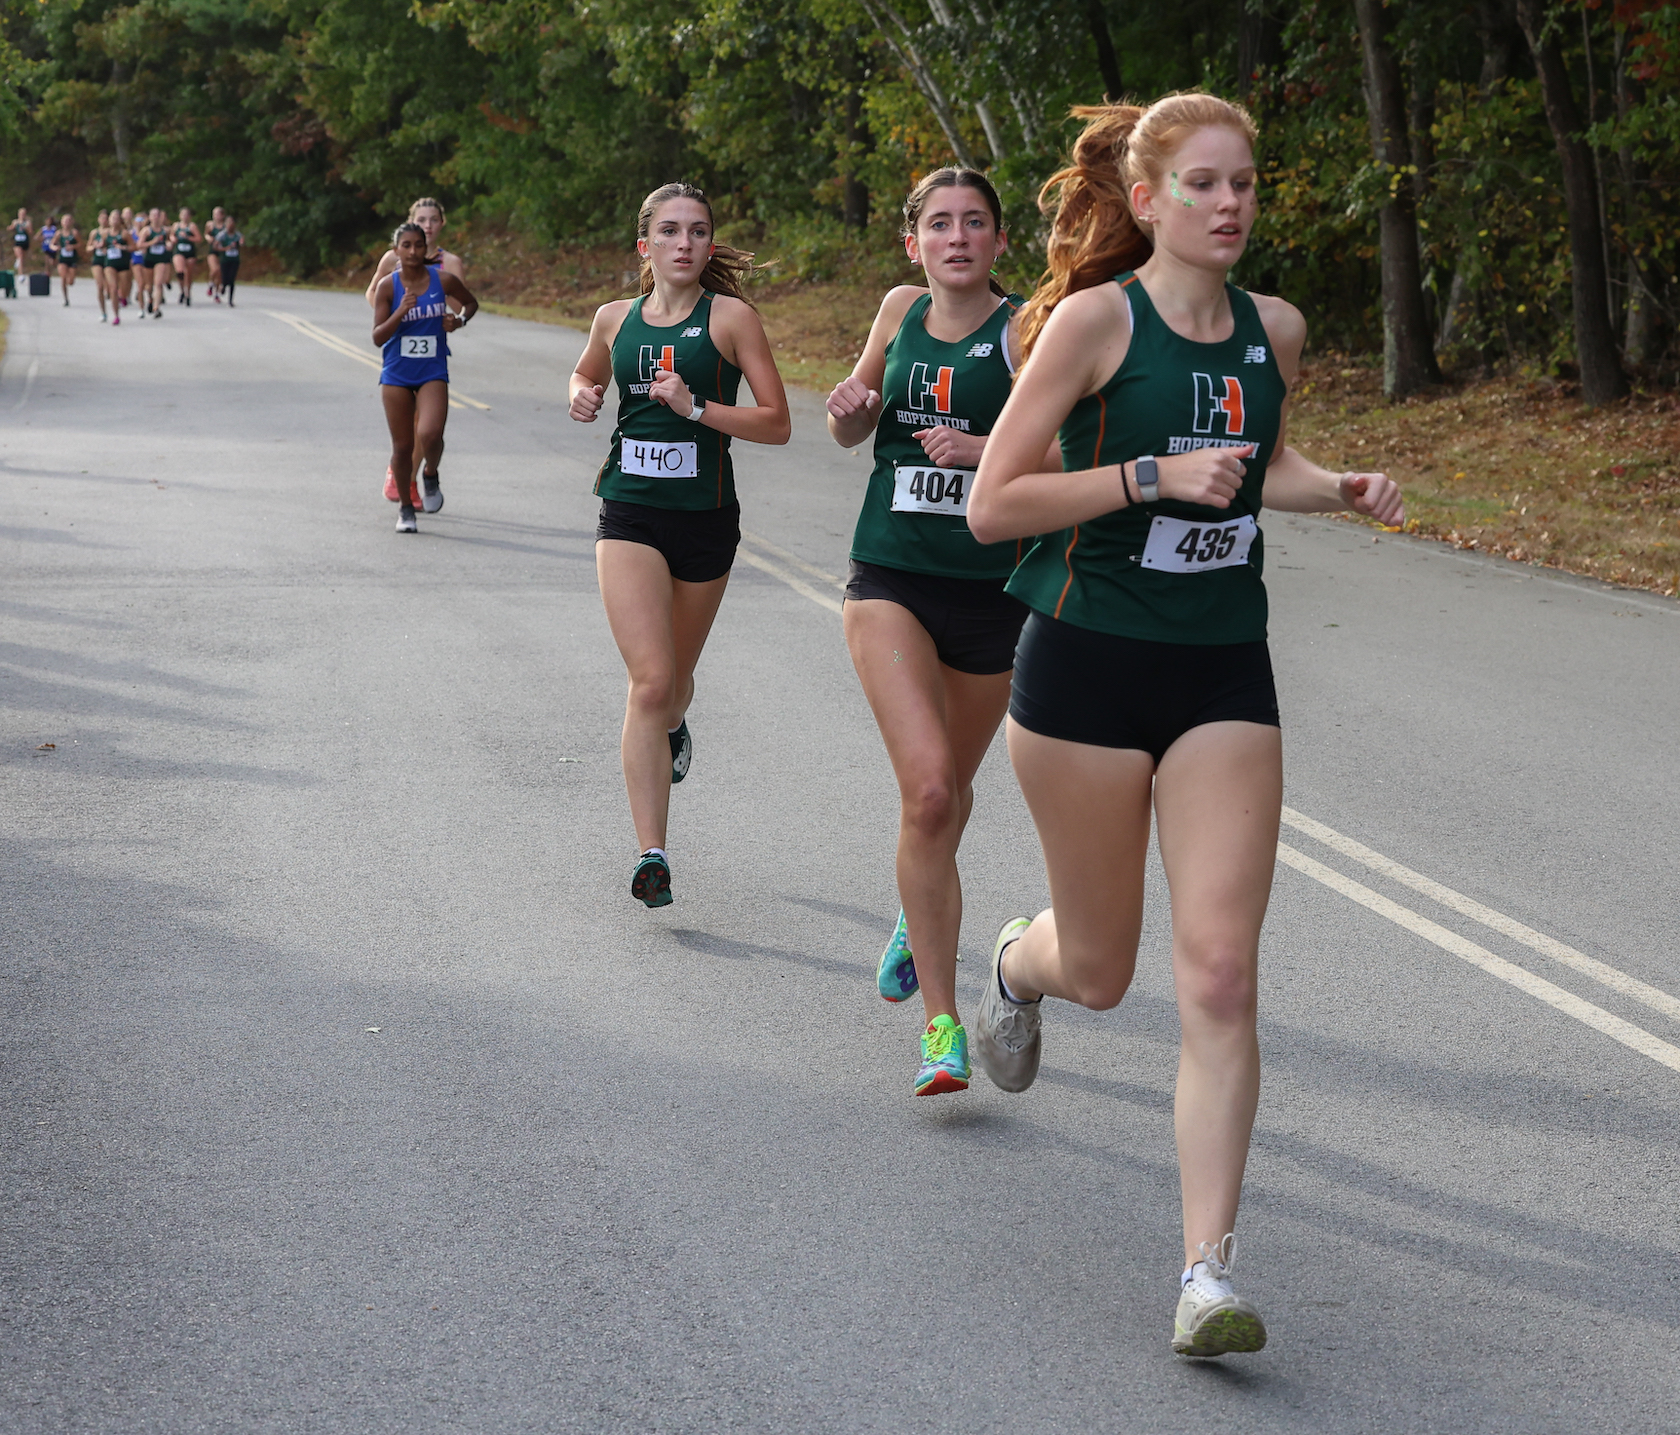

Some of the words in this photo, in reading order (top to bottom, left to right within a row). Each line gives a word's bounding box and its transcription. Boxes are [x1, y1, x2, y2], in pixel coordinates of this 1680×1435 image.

[408, 339, 429, 355] 23
[908, 361, 955, 414] H
[1192, 371, 1245, 436] H
[896, 409, 971, 431] HOPKINTON
[634, 445, 683, 471] 440
[909, 470, 964, 505] 404
[1175, 524, 1240, 563] 435
